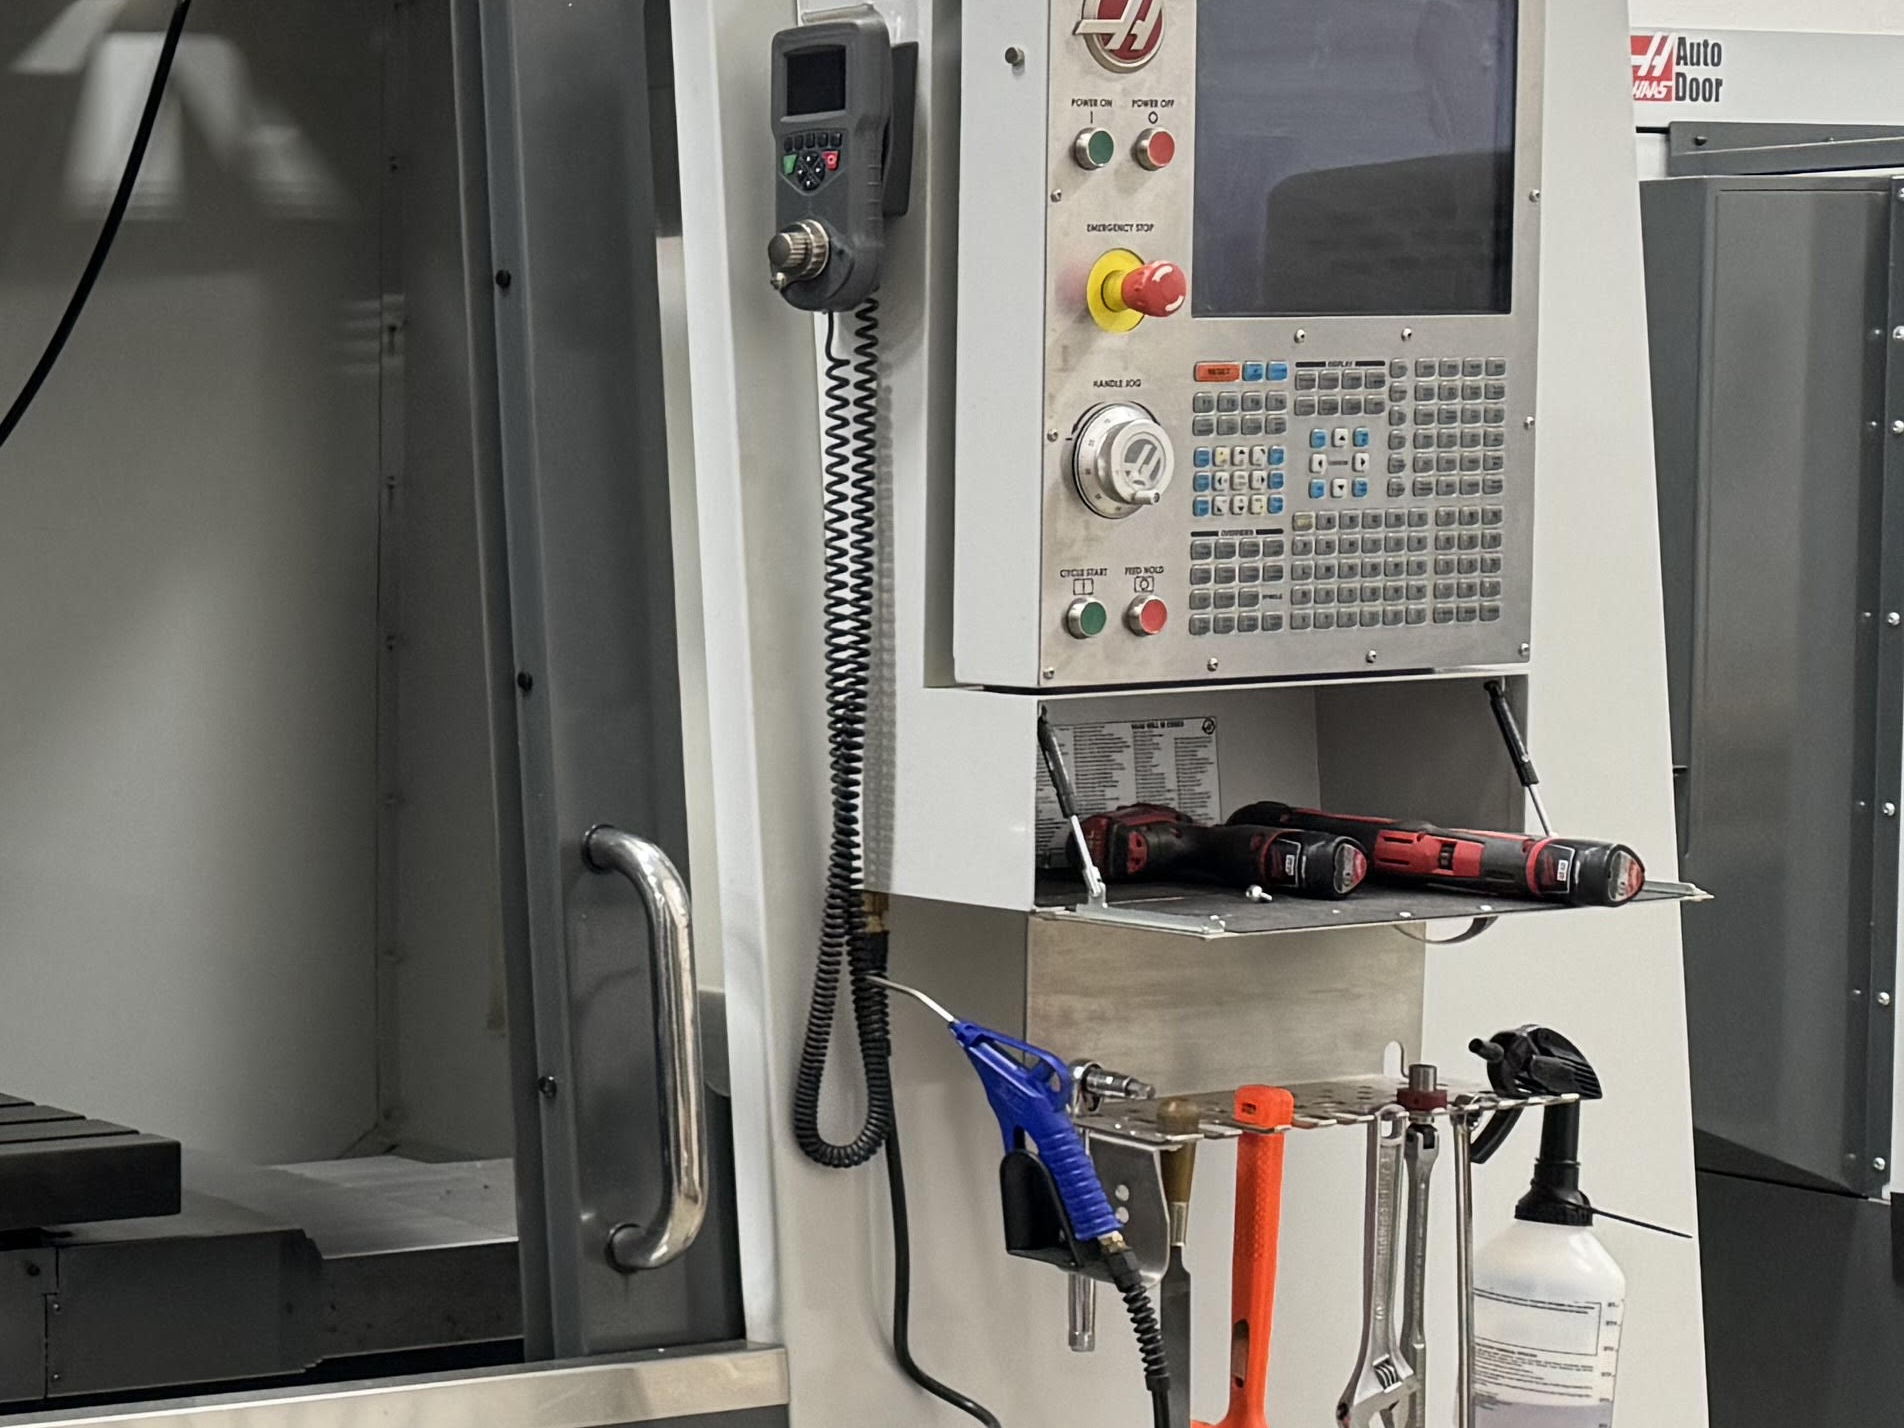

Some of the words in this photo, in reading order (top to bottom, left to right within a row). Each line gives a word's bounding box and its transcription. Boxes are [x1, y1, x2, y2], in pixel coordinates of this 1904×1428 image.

[1675, 36, 1723, 68] Auto
[1674, 72, 1723, 103] Door
[1071, 98, 1098, 108] POWER
[1131, 99, 1159, 109] POWER
